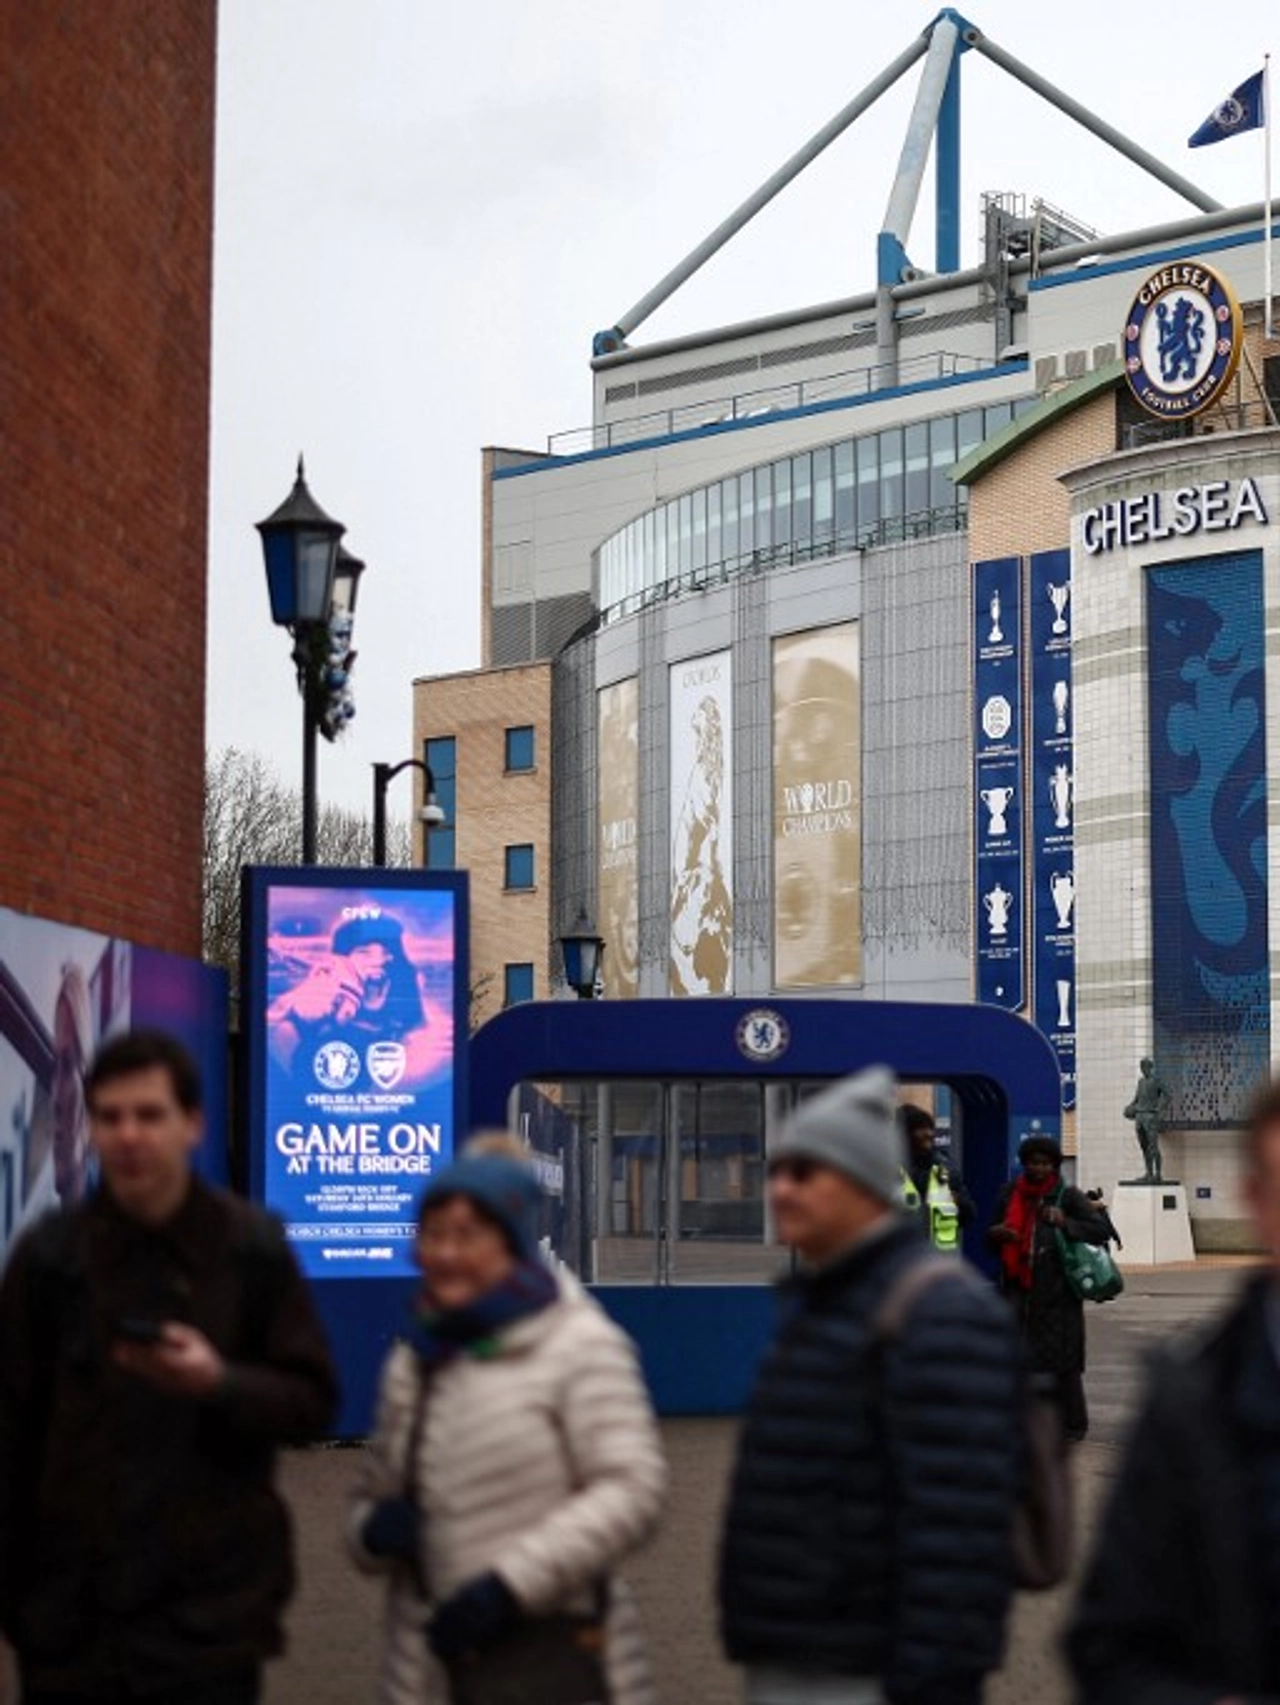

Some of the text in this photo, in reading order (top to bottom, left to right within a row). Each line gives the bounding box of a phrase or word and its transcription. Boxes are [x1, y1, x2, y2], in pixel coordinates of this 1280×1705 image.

[1140, 267, 1211, 305] CHELSEA
[1142, 375, 1216, 409] FOOTBALL CLUB
[1082, 477, 1268, 555] CHELSEA
[275, 1122, 441, 1156] GAME ON
[287, 1155, 432, 1175] AT THE BRIDGE
